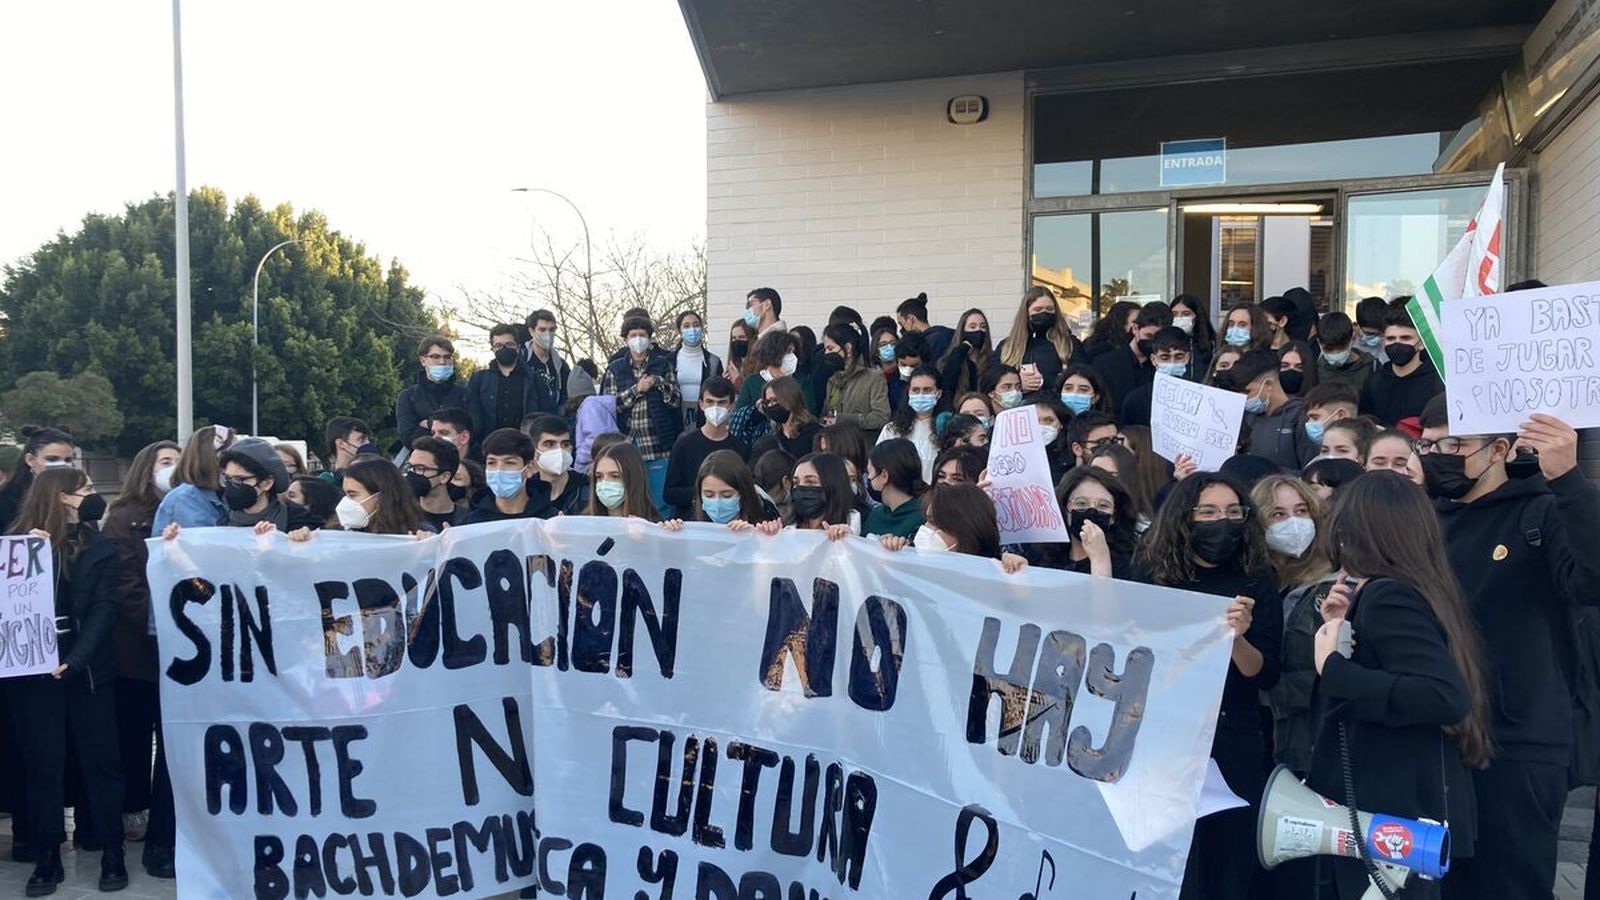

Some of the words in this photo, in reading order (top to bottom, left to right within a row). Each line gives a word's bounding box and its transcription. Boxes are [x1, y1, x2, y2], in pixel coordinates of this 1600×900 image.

[1164, 155, 1223, 169] ENTRADA
[1464, 306, 1501, 341] YA
[1455, 348, 1484, 375] DE
[1496, 337, 1595, 372] JUGAR
[1000, 410, 1033, 448] NO
[1205, 428, 1234, 450] SER
[989, 451, 1027, 478] UEDO
[8, 582, 39, 598] POR
[14, 602, 32, 615] UN
[166, 577, 277, 685] SIN
[315, 538, 682, 679] EDUCACIÓN
[760, 577, 907, 711] NO
[967, 617, 1154, 783] HAY
[205, 722, 376, 818] ARTE
[609, 726, 877, 891] CULTURA
